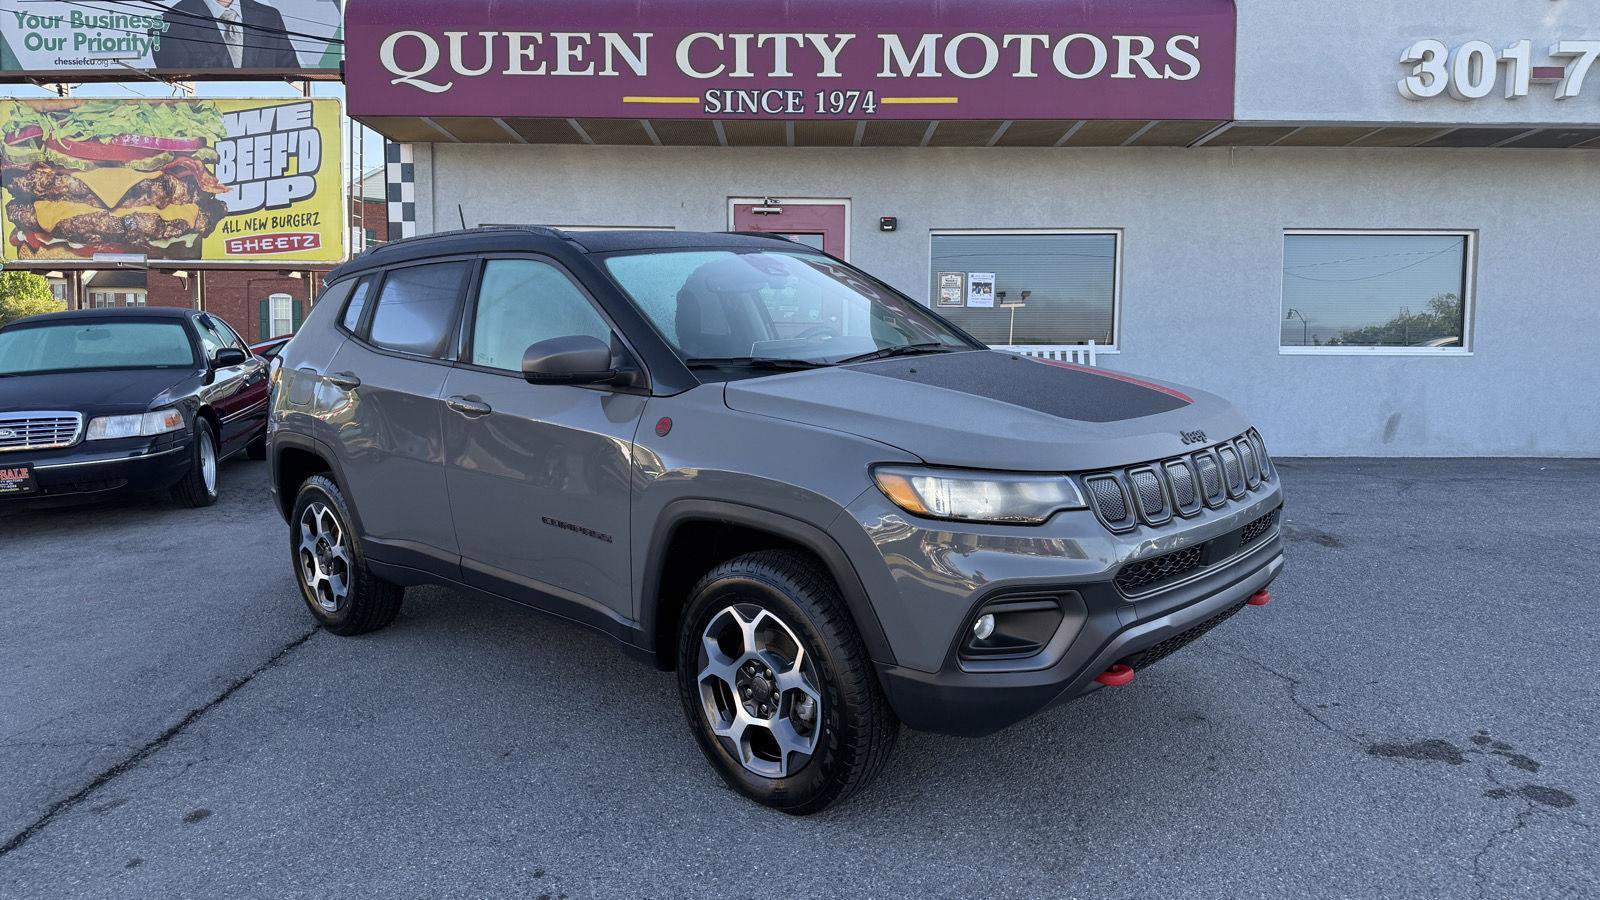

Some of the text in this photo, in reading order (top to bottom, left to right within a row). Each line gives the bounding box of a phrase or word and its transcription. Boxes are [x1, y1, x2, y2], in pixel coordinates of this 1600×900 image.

[13, 10, 170, 32] Your Business,
[24, 31, 161, 56] Our Priority!
[54, 57, 109, 67] chessiefcu.org
[379, 30, 1201, 93] QUEEN CITY MOTORS
[704, 89, 877, 113] SINCE 1974
[223, 101, 313, 139] WE
[215, 127, 322, 185] BEEF'D
[215, 175, 317, 216] UP
[222, 212, 321, 234] ALL NEW BURGERZ
[230, 235, 315, 252] SHEETZ
